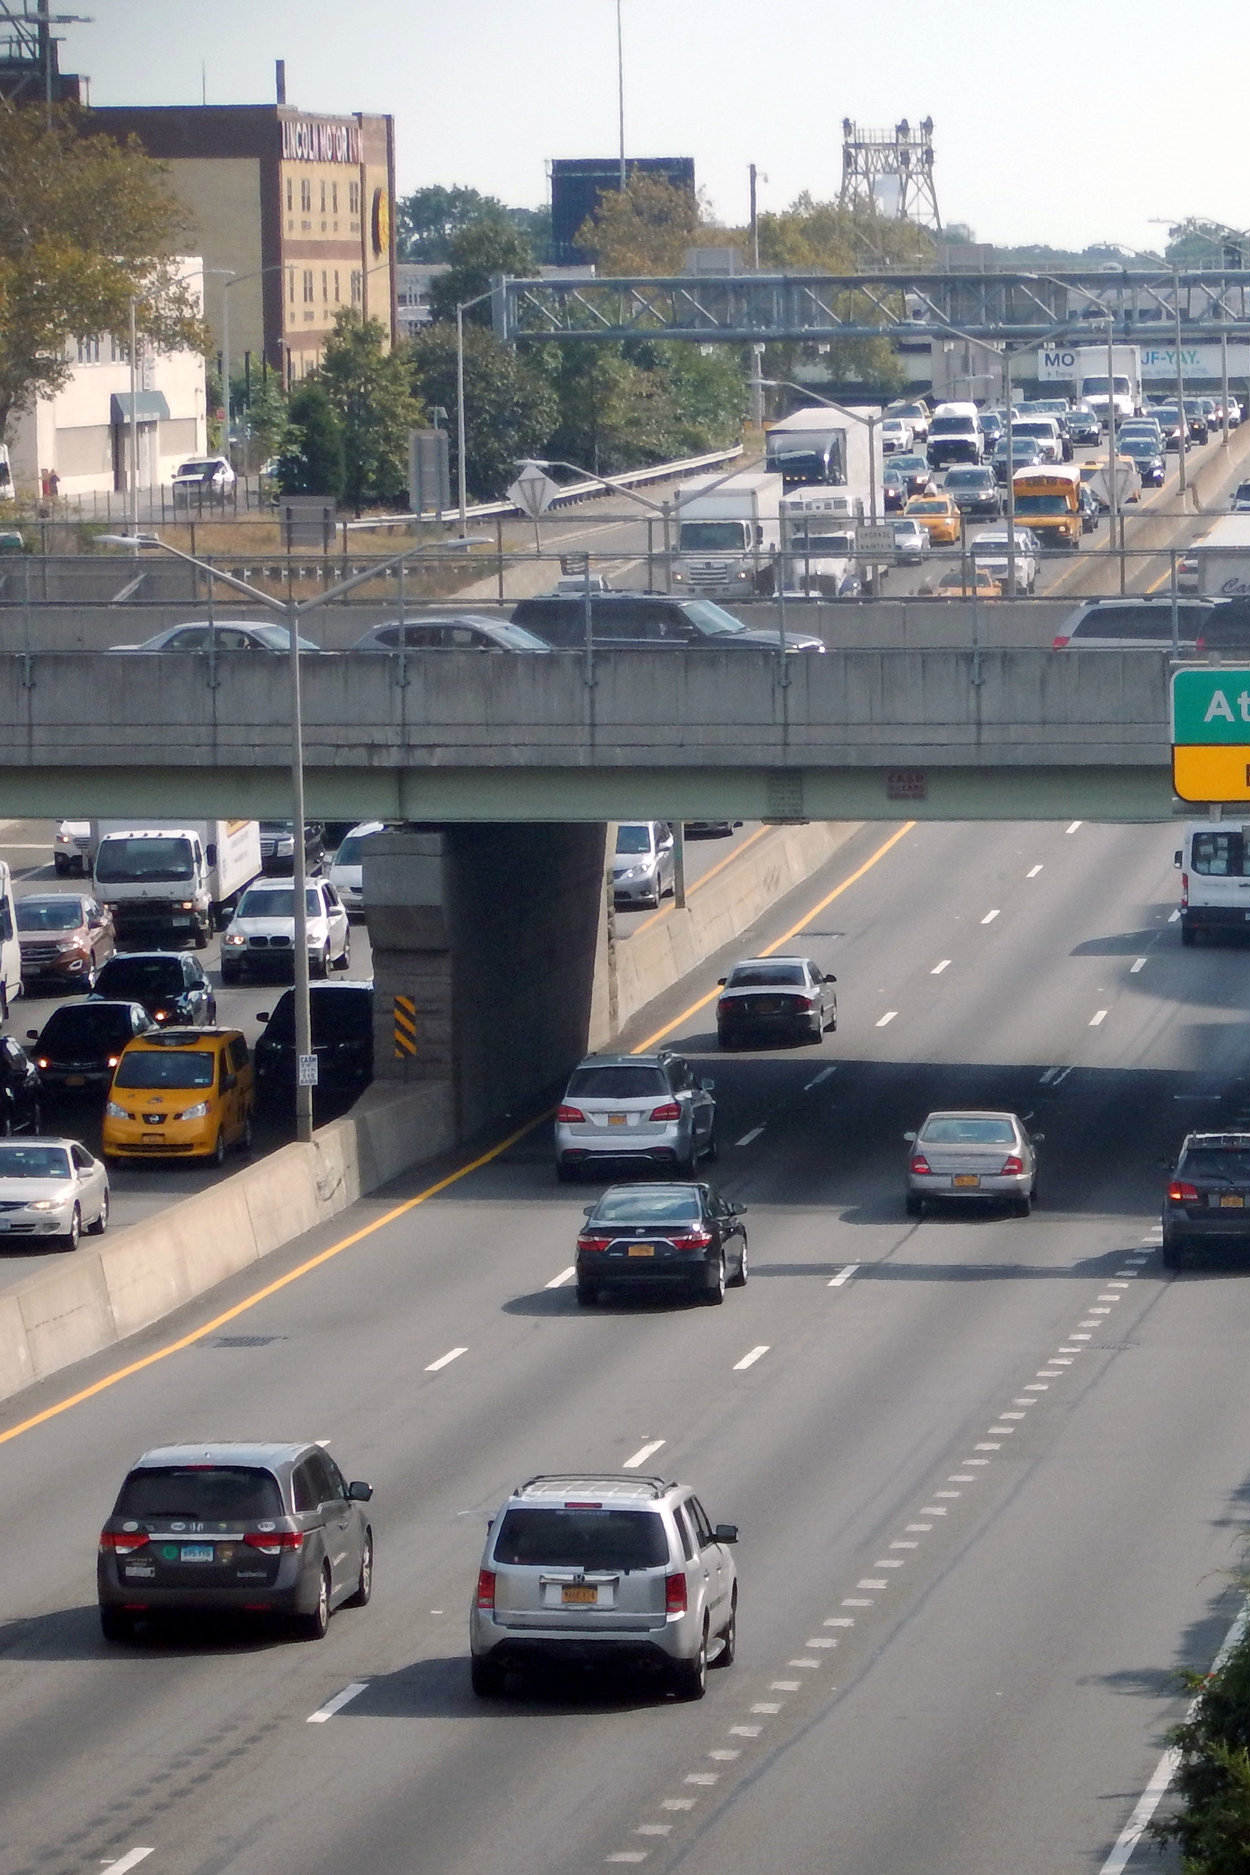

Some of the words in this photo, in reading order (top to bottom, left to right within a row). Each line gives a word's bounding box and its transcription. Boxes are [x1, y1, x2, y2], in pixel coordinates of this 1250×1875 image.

[282, 120, 319, 160] LINCOLN
[320, 124, 348, 164] MOTOR
[349, 127, 363, 165] INN
